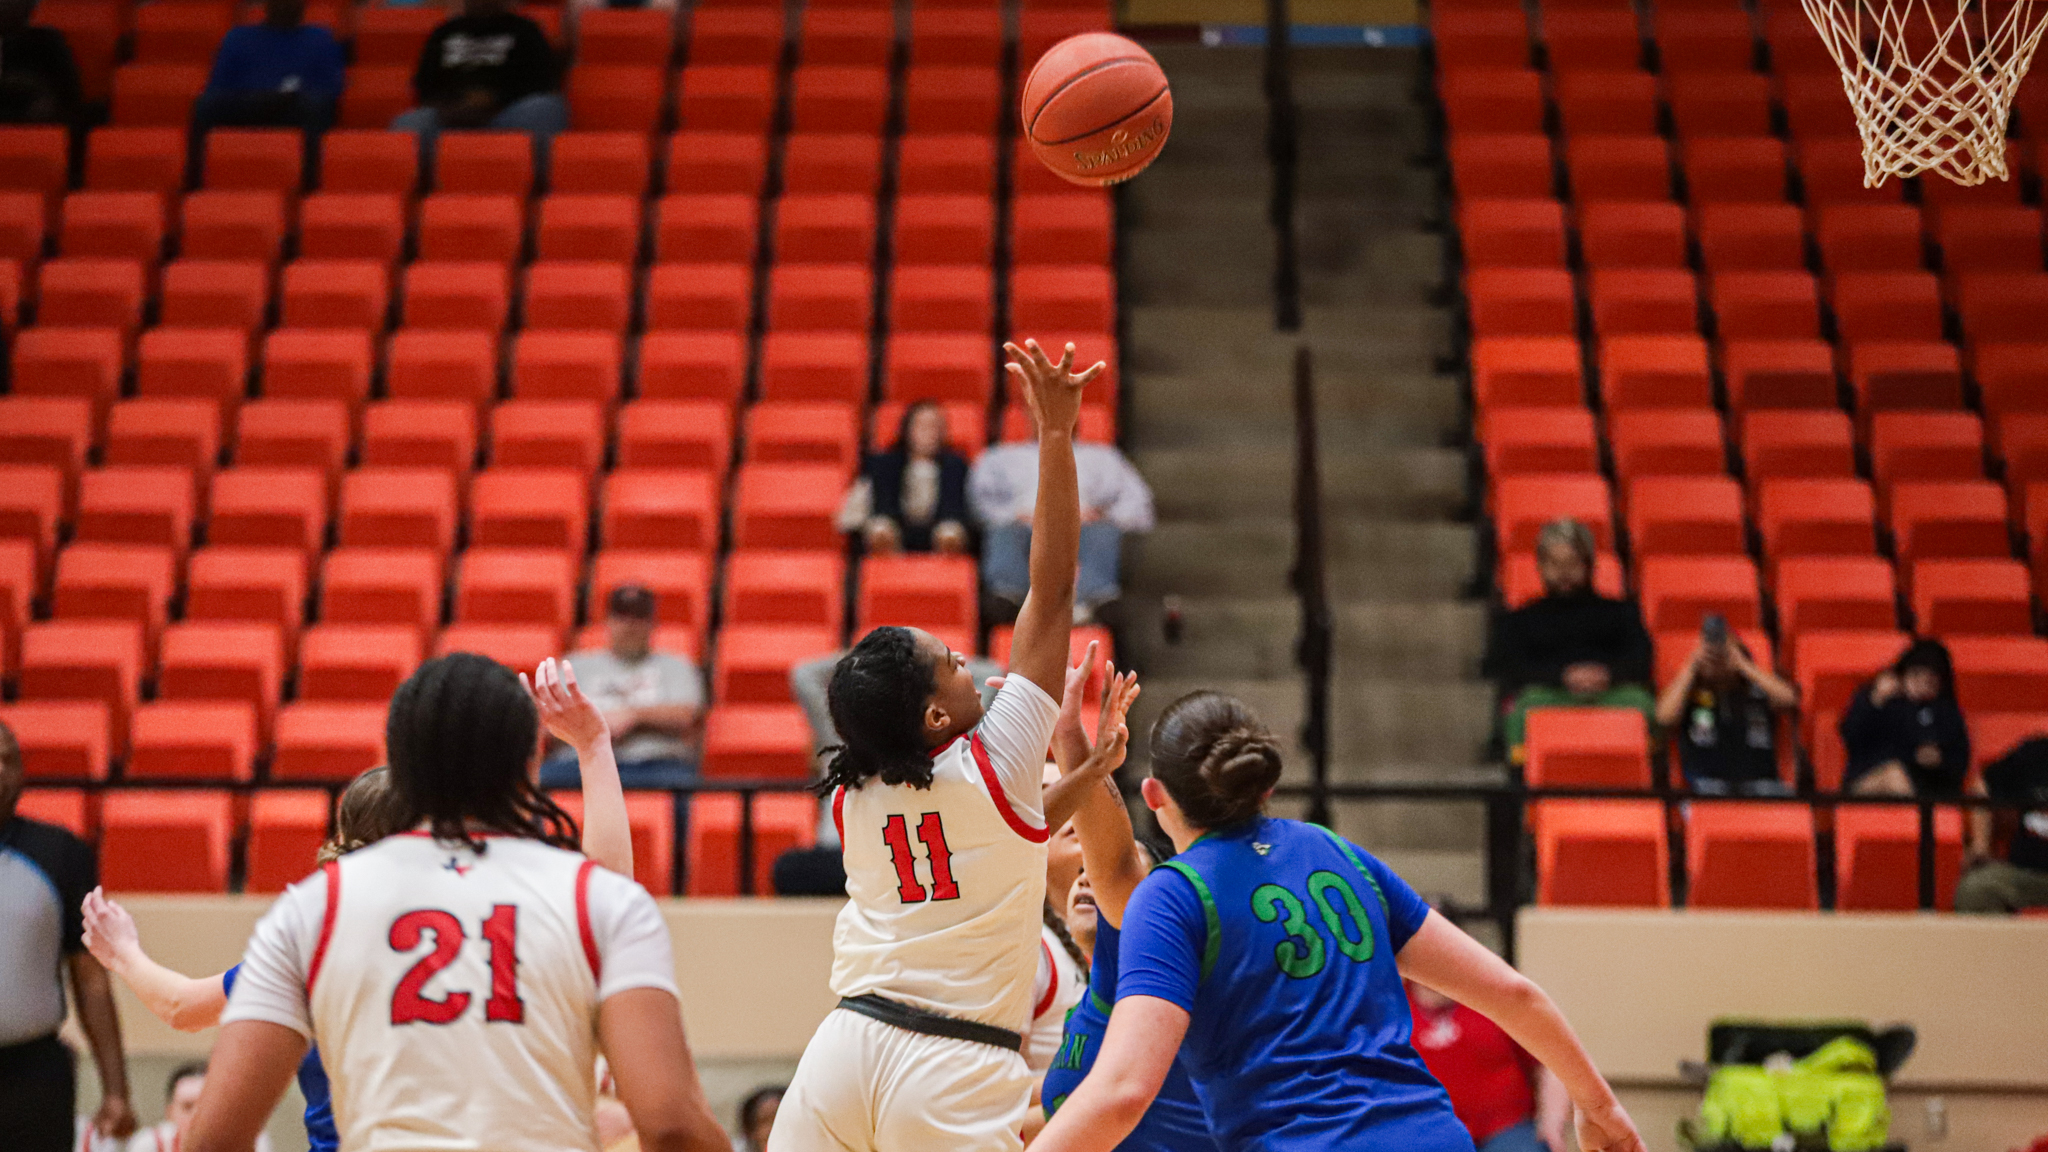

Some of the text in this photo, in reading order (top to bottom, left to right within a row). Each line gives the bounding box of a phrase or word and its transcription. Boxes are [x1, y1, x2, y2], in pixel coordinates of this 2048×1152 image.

[1073, 116, 1163, 169] SPALDING
[882, 811, 960, 904] 11
[388, 903, 525, 1026] 21
[1251, 869, 1375, 980] 30
